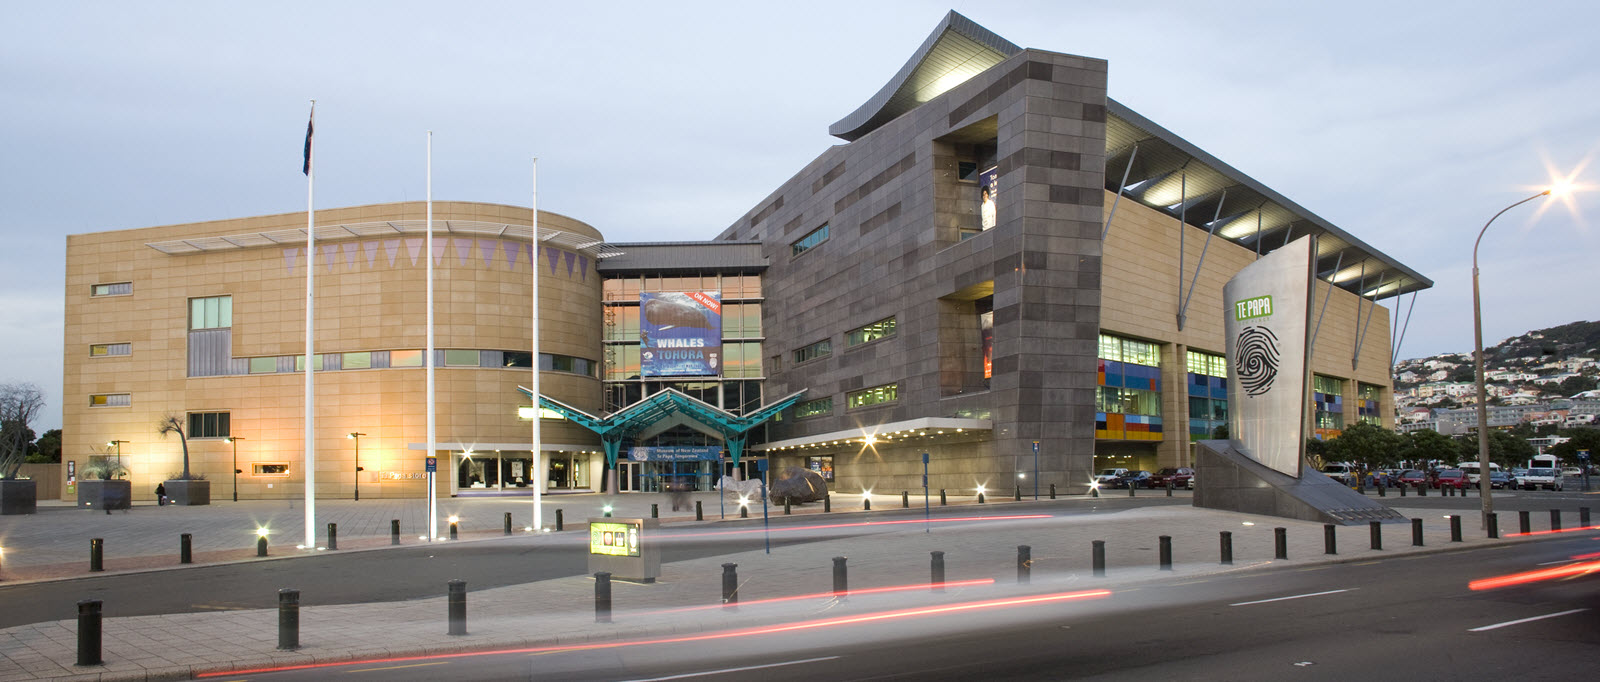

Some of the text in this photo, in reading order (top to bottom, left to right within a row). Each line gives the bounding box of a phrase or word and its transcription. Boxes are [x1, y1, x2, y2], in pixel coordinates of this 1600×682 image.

[694, 292, 719, 310] ON NOW!
[1237, 297, 1271, 319] TE PAPA
[656, 338, 704, 348] WHALES
